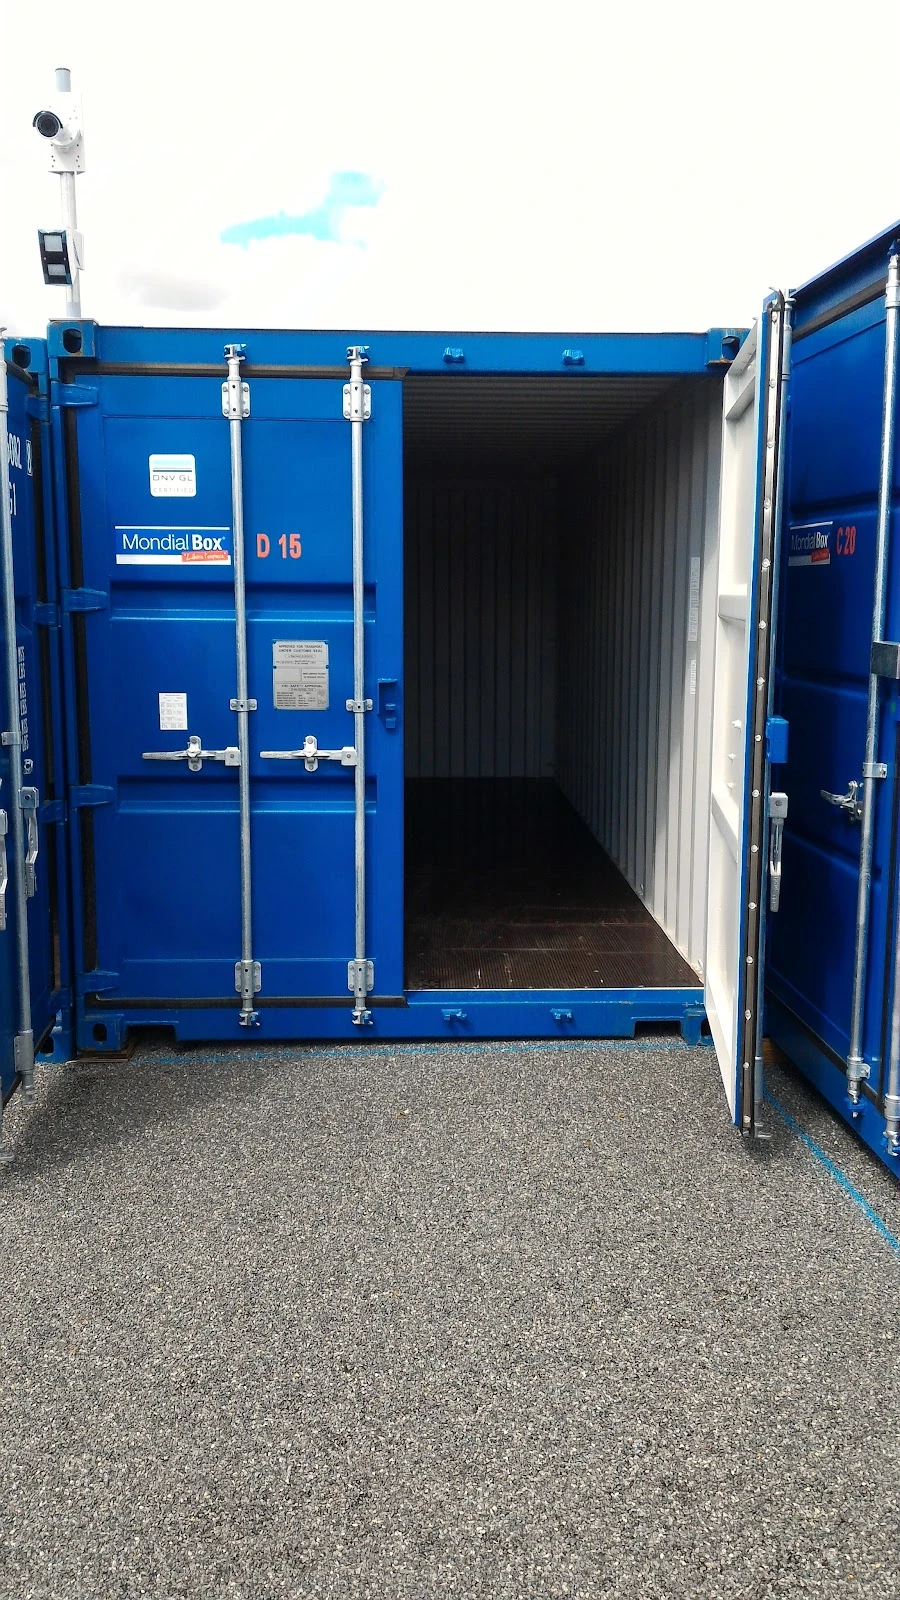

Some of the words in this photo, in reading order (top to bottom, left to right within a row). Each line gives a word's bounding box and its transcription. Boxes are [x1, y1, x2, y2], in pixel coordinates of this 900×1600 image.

[179, 474, 193, 482] GL
[122, 533, 189, 551] Mondial
[256, 533, 270, 559] D
[278, 533, 302, 559] 15
[791, 533, 816, 550] Mondial
[837, 527, 843, 554] C
[844, 526, 856, 555] 20
